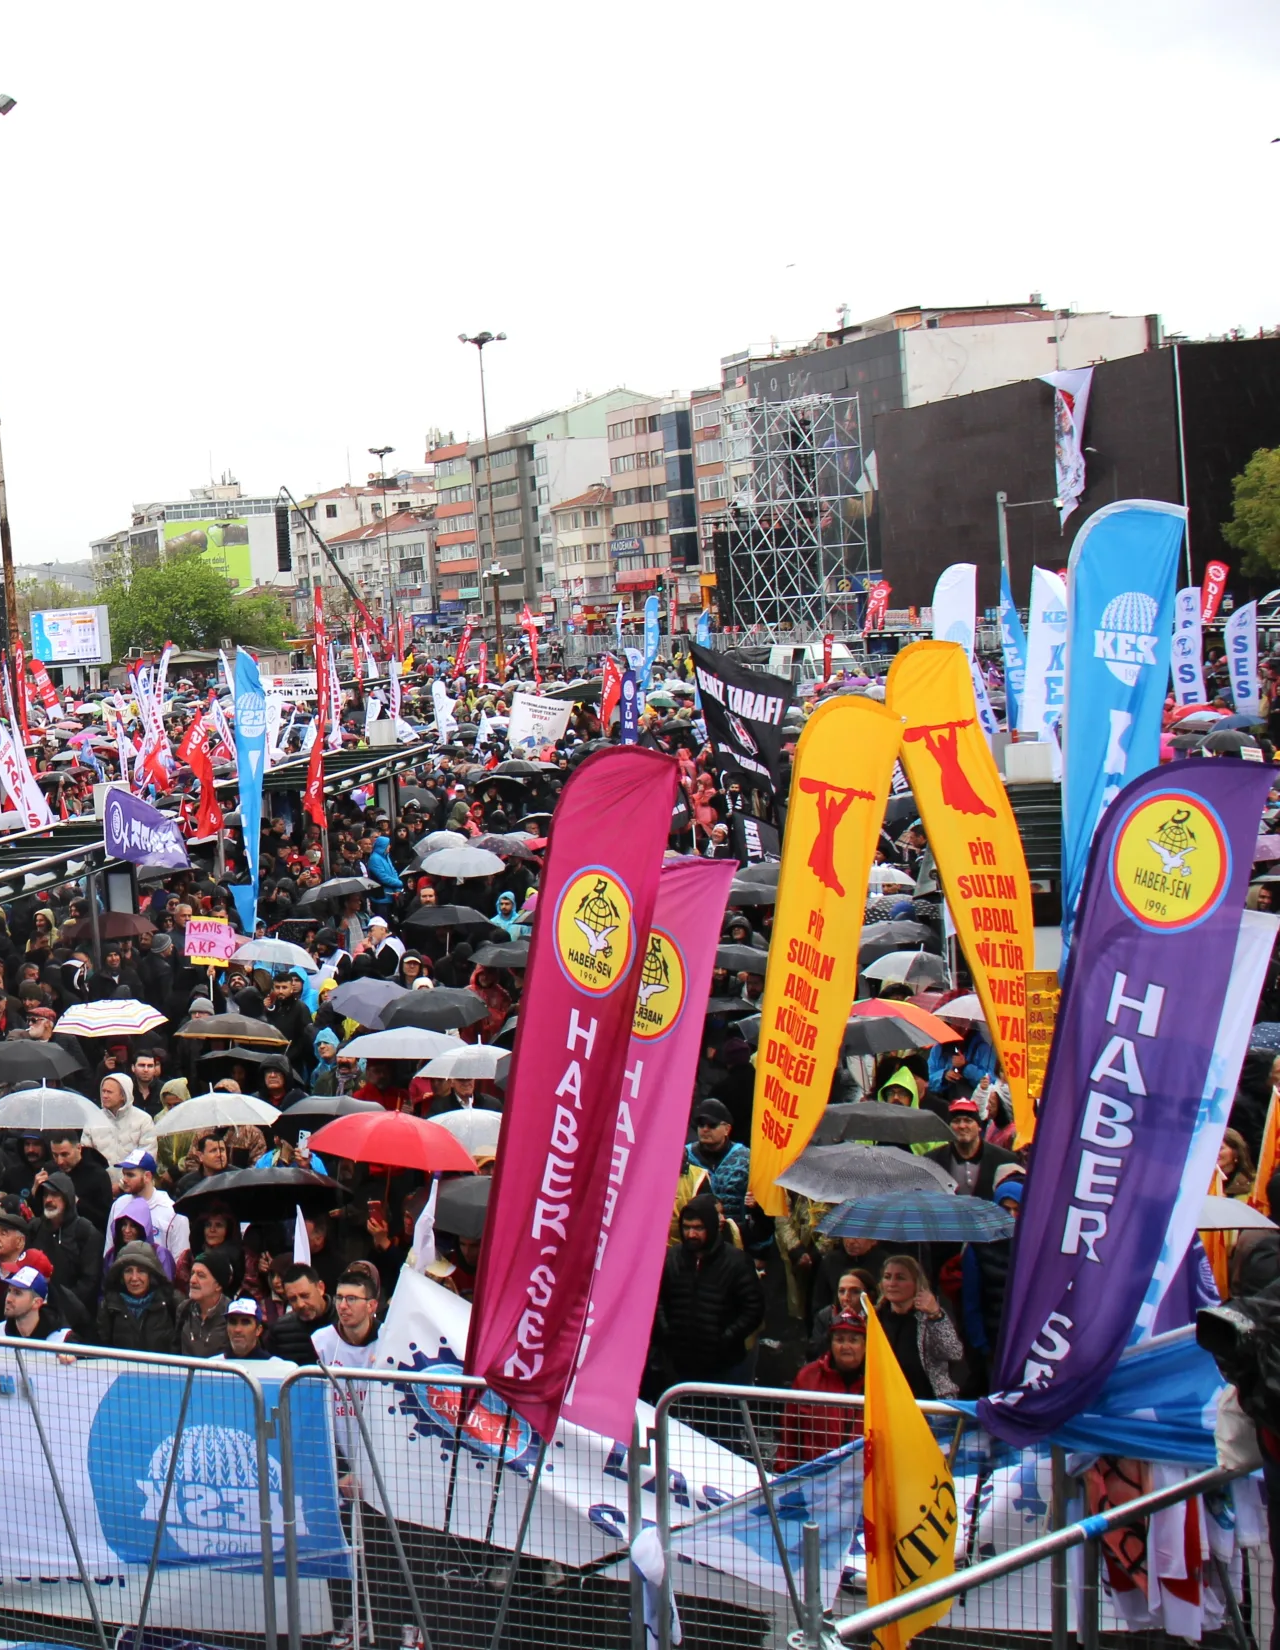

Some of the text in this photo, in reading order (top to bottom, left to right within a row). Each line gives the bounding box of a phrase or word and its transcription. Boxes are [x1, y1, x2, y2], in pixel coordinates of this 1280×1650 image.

[1232, 635, 1252, 699] SES
[624, 702, 634, 729] TÜM
[727, 685, 784, 725] TARAFI
[968, 837, 996, 866] PİR
[957, 874, 1017, 900] SULTAN
[1133, 867, 1192, 901] HABER-SEN
[971, 908, 1018, 934] ABDAL
[1144, 899, 1168, 917] 1996
[189, 922, 233, 938] MAYIS 1
[187, 941, 216, 954] AKP
[787, 938, 836, 982] SULTAN
[567, 948, 613, 980] HABER-SEN
[578, 970, 599, 986] 1996
[1030, 1012, 1044, 1023] 8A
